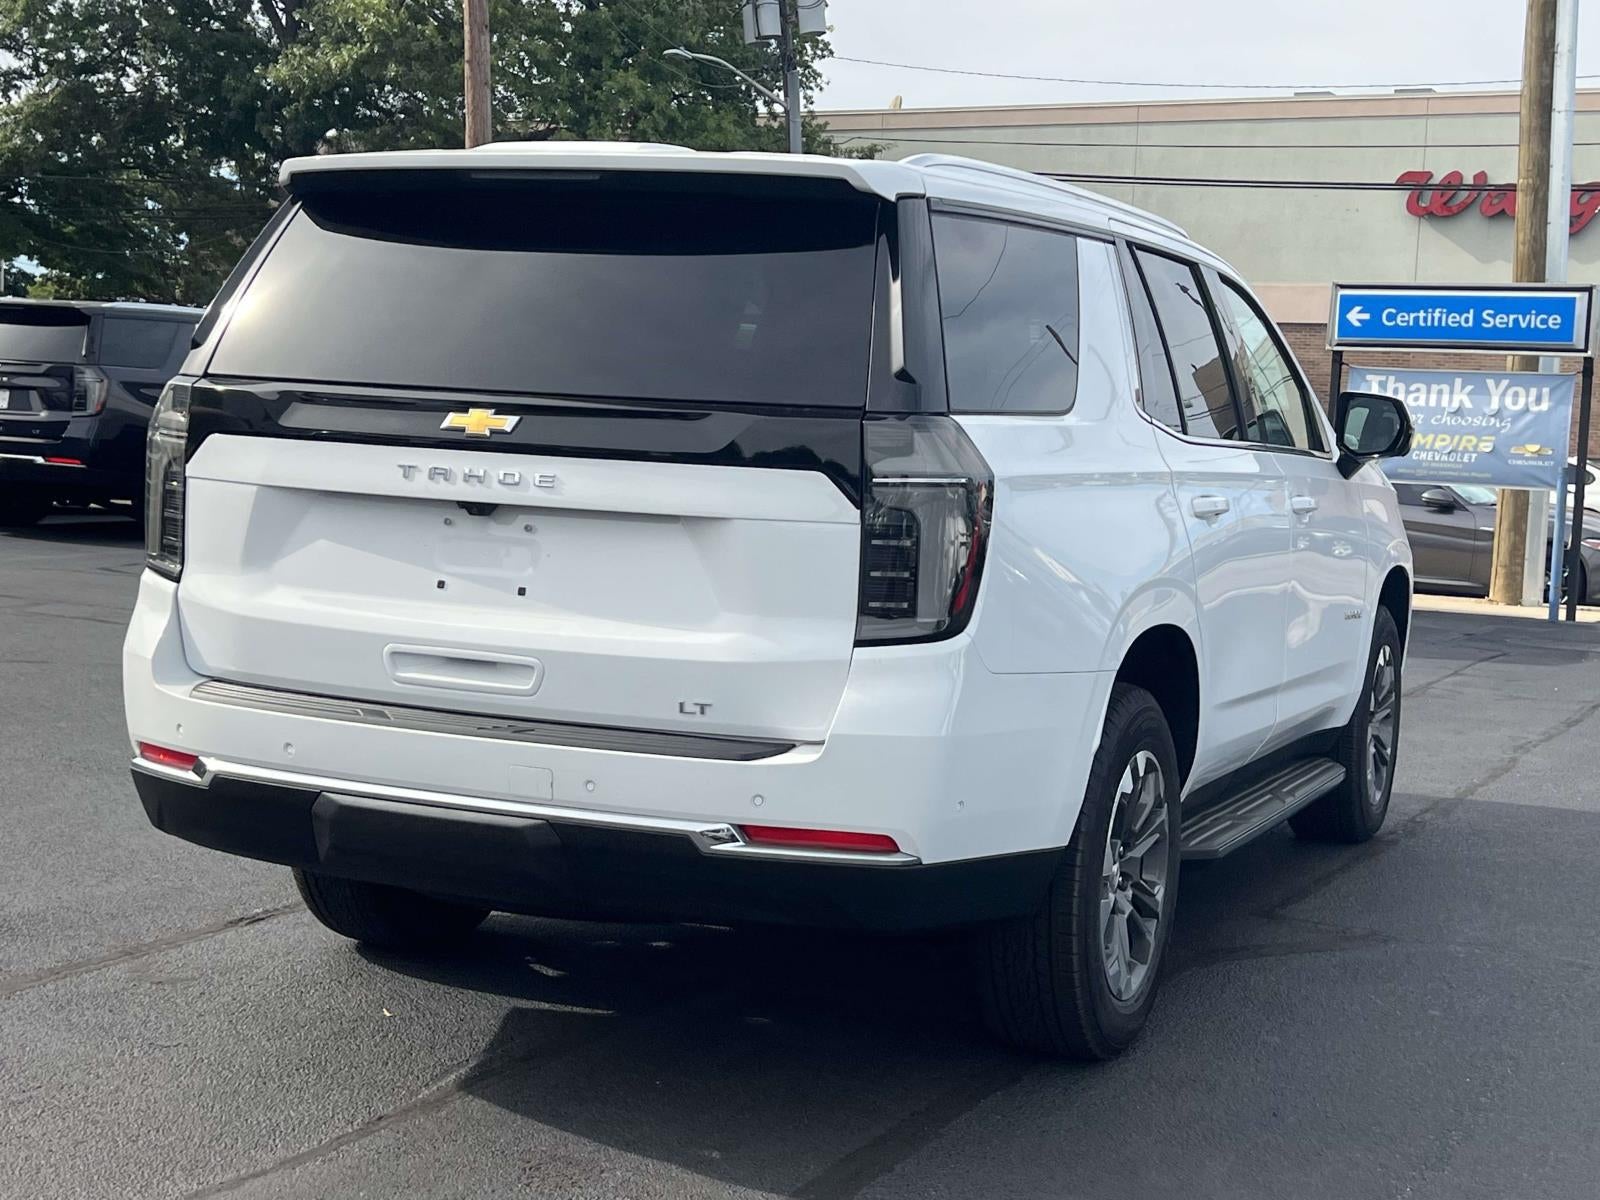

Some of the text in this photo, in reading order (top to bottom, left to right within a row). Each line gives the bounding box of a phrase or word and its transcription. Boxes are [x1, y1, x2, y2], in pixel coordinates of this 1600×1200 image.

[1395, 170, 1600, 235] Wag
[1381, 308, 1562, 330] Certified Service
[1366, 374, 1551, 413] Thank You
[1430, 408, 1512, 433] choosing
[1411, 432, 1496, 453] MPIRE
[397, 463, 557, 488] TAHOE
[678, 701, 713, 715] LT
